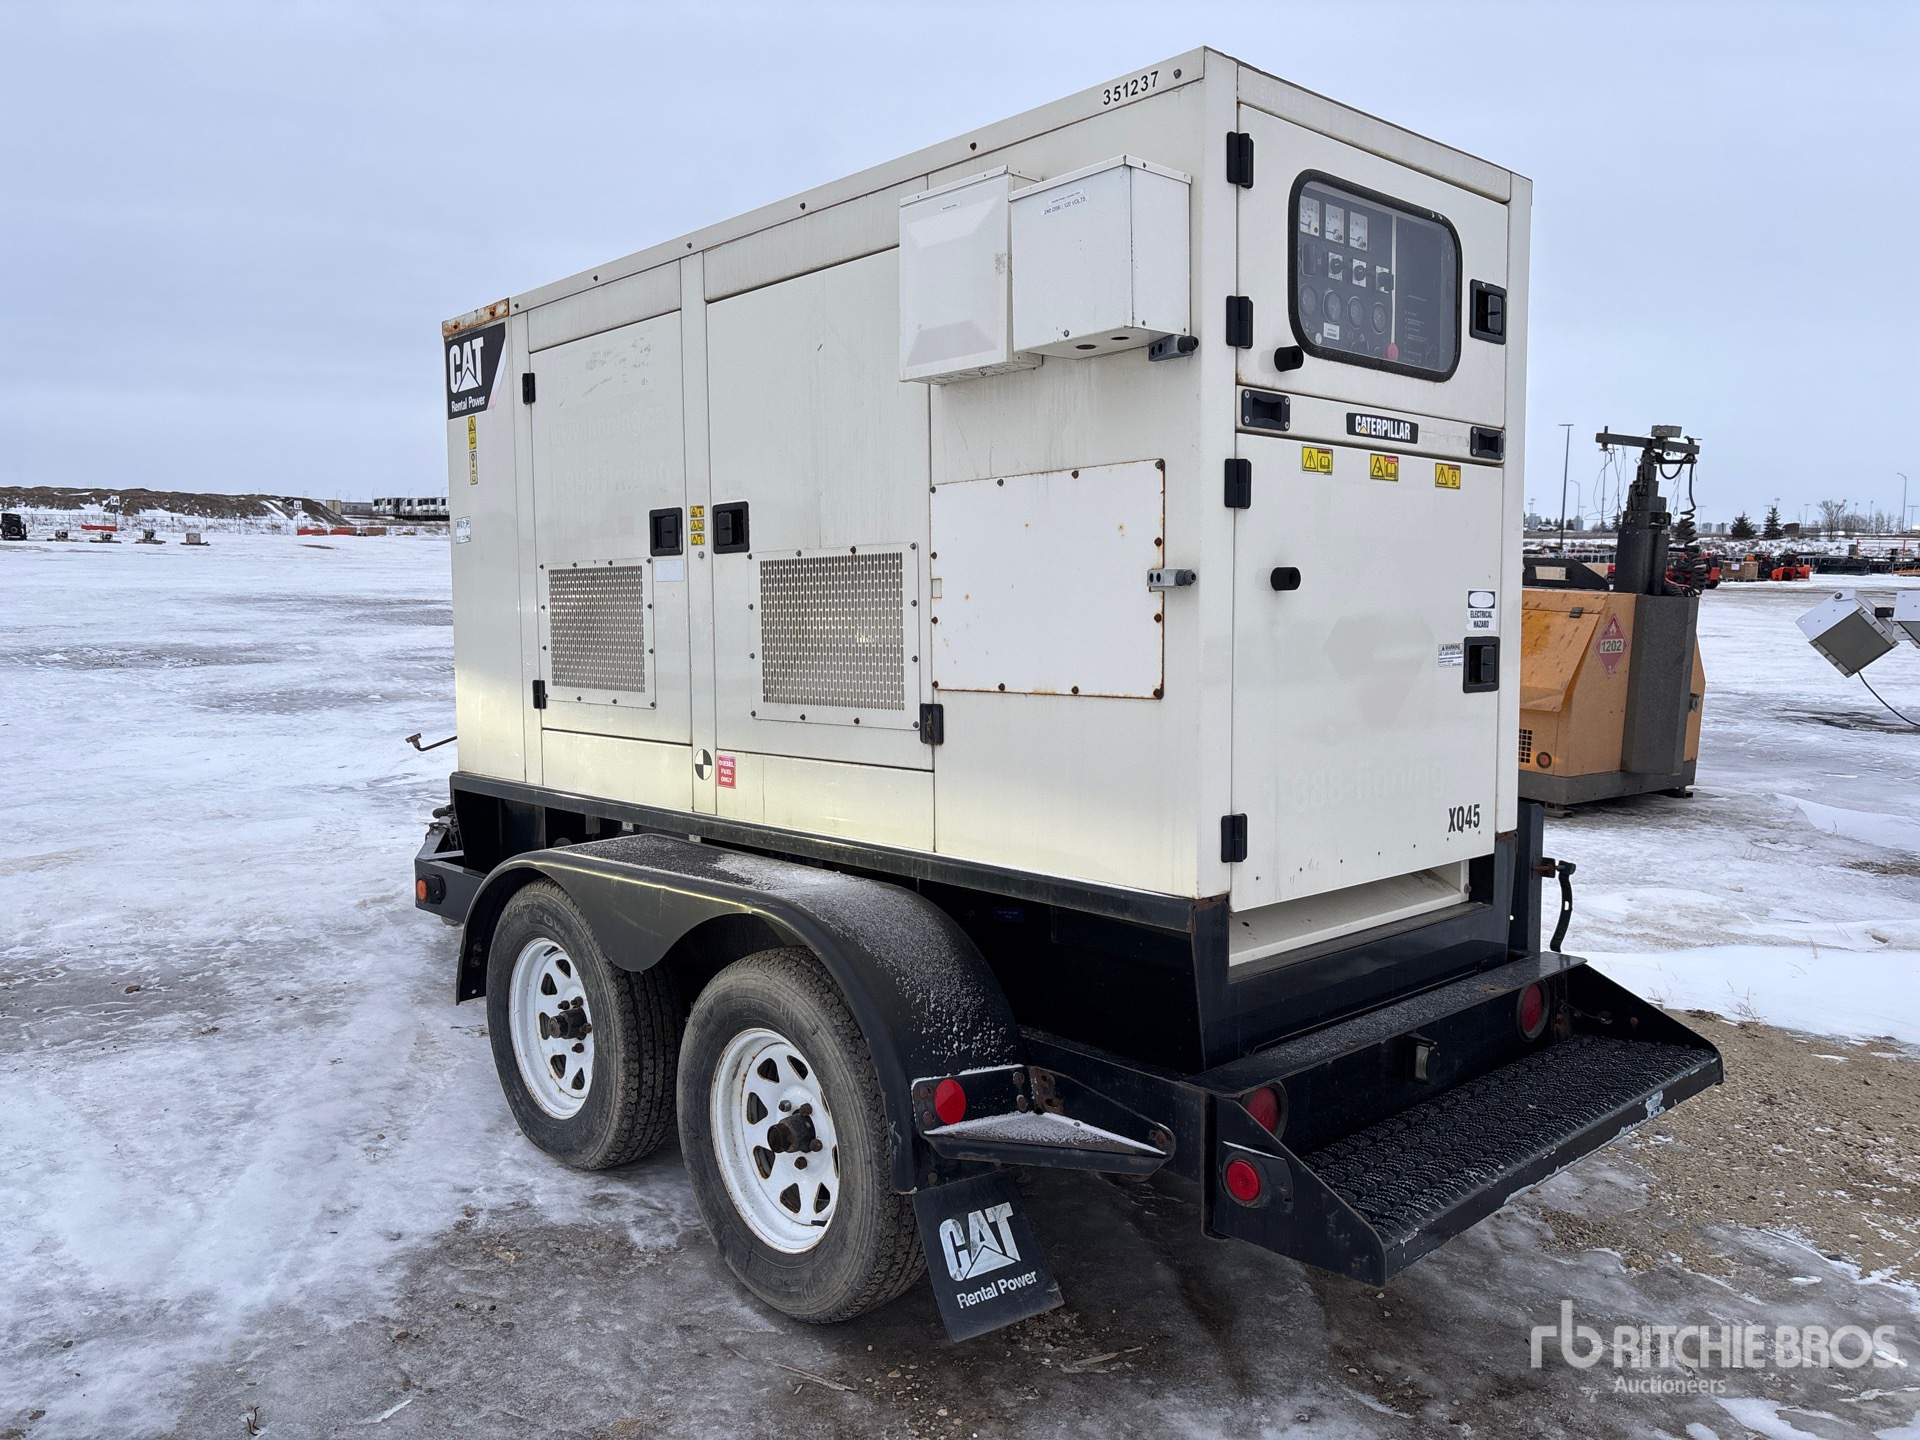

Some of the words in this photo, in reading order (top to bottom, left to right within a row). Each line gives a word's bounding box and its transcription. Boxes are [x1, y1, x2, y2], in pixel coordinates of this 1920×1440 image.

[1103, 70, 1159, 105] 351237
[449, 336, 484, 394] CAT
[451, 397, 468, 413] Rental
[469, 394, 486, 409] Power
[1355, 415, 1411, 440] CATERPILLAR
[1470, 610, 1493, 619] ELECTRICAL
[1473, 620, 1490, 628] HAZARD
[1601, 640, 1622, 652] 1202
[1448, 804, 1480, 833] XQ45
[939, 1201, 1022, 1282] CAT
[956, 1282, 999, 1309] Rental
[997, 1270, 1038, 1295] Power
